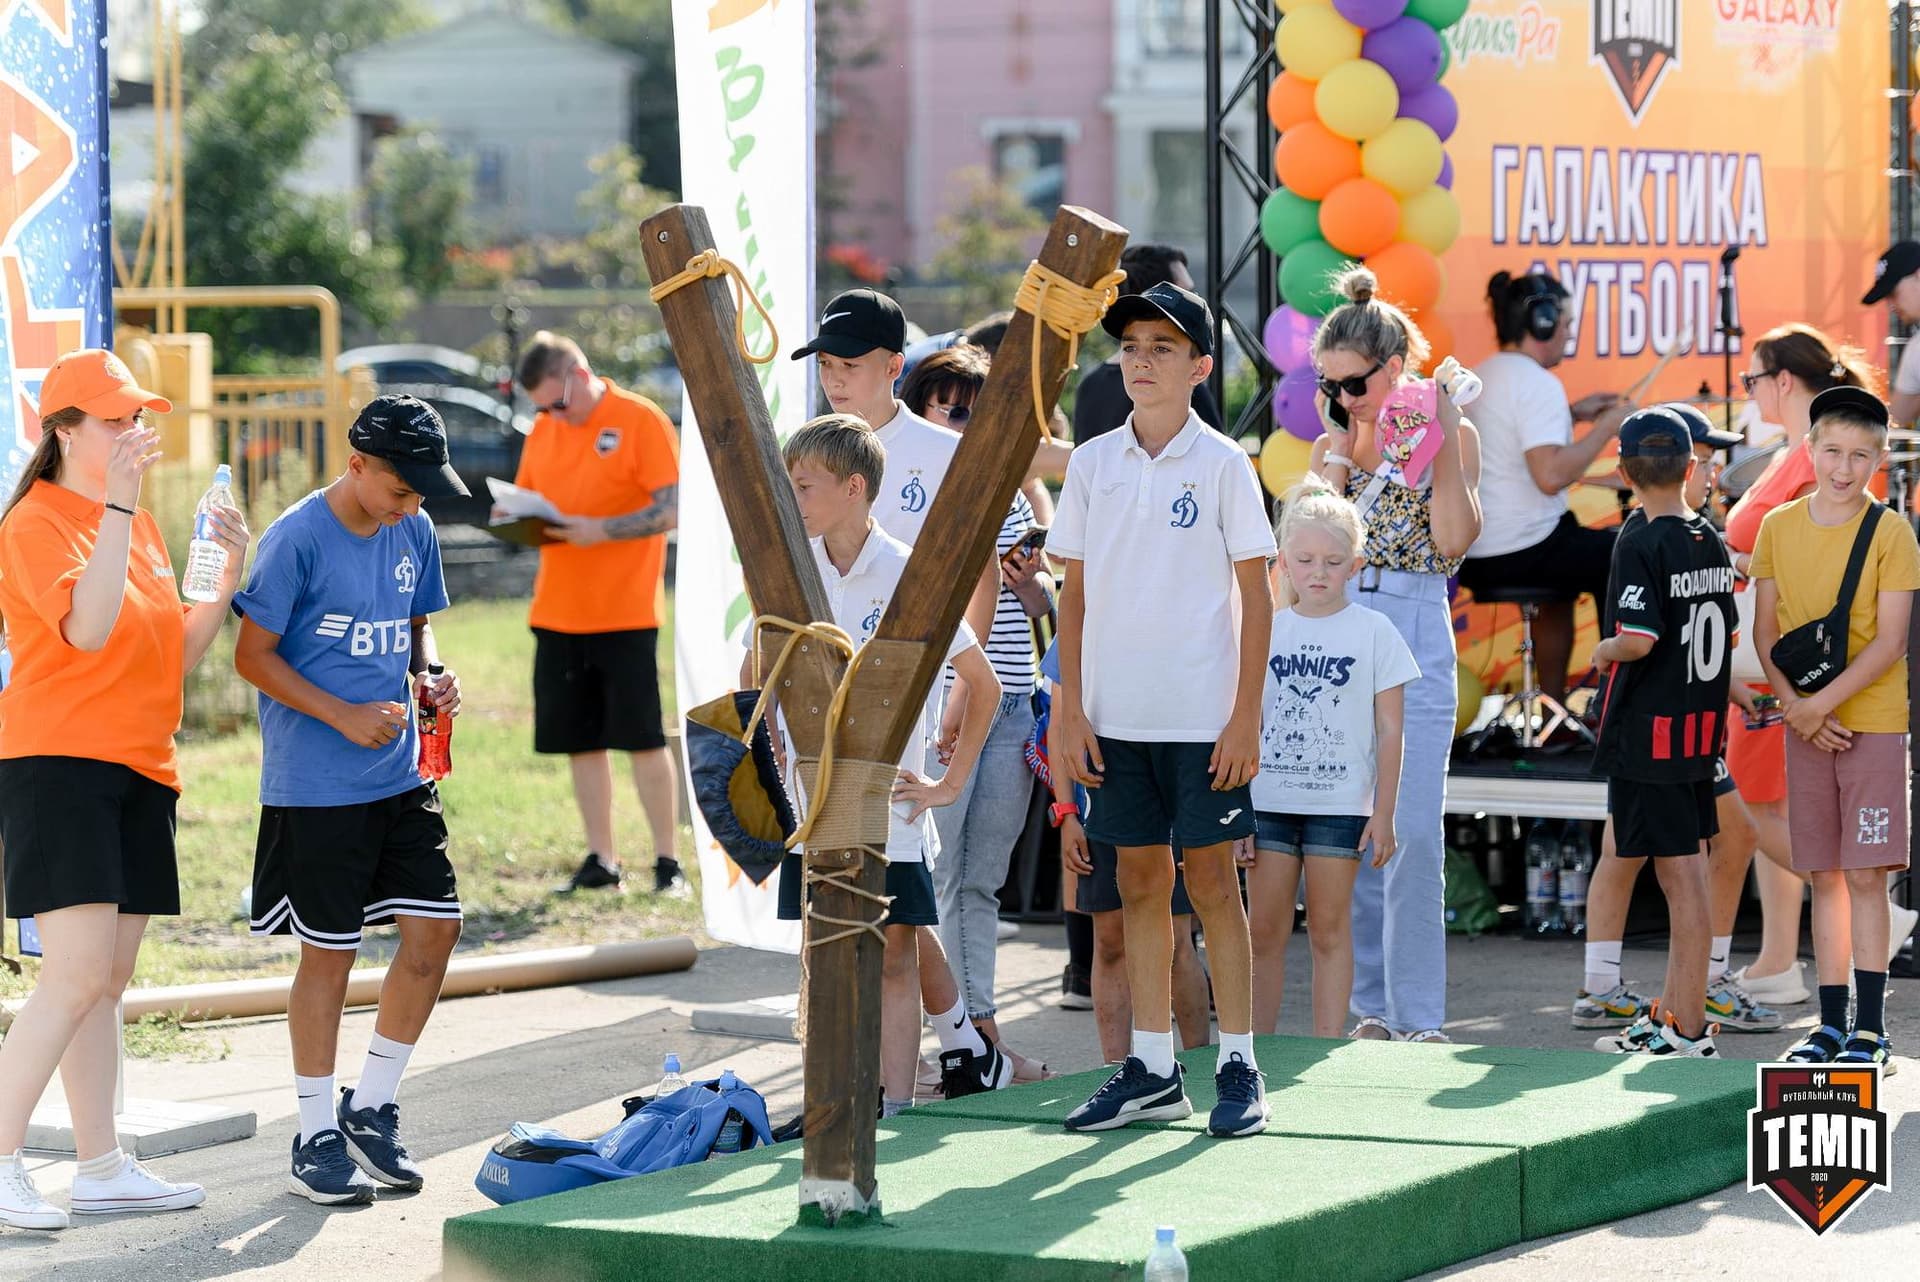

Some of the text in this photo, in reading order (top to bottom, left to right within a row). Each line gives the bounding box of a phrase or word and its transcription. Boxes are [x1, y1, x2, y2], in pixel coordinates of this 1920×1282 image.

[1718, 0, 1838, 28] GALAXY
[1492, 145, 1768, 246] ГАЛАКТИКА
[1529, 259, 1741, 358] УТБОЛА
[1680, 600, 1726, 684] 10
[1807, 670, 1822, 680] Do
[1259, 762, 1310, 772] OIN-OUR-CLUB
